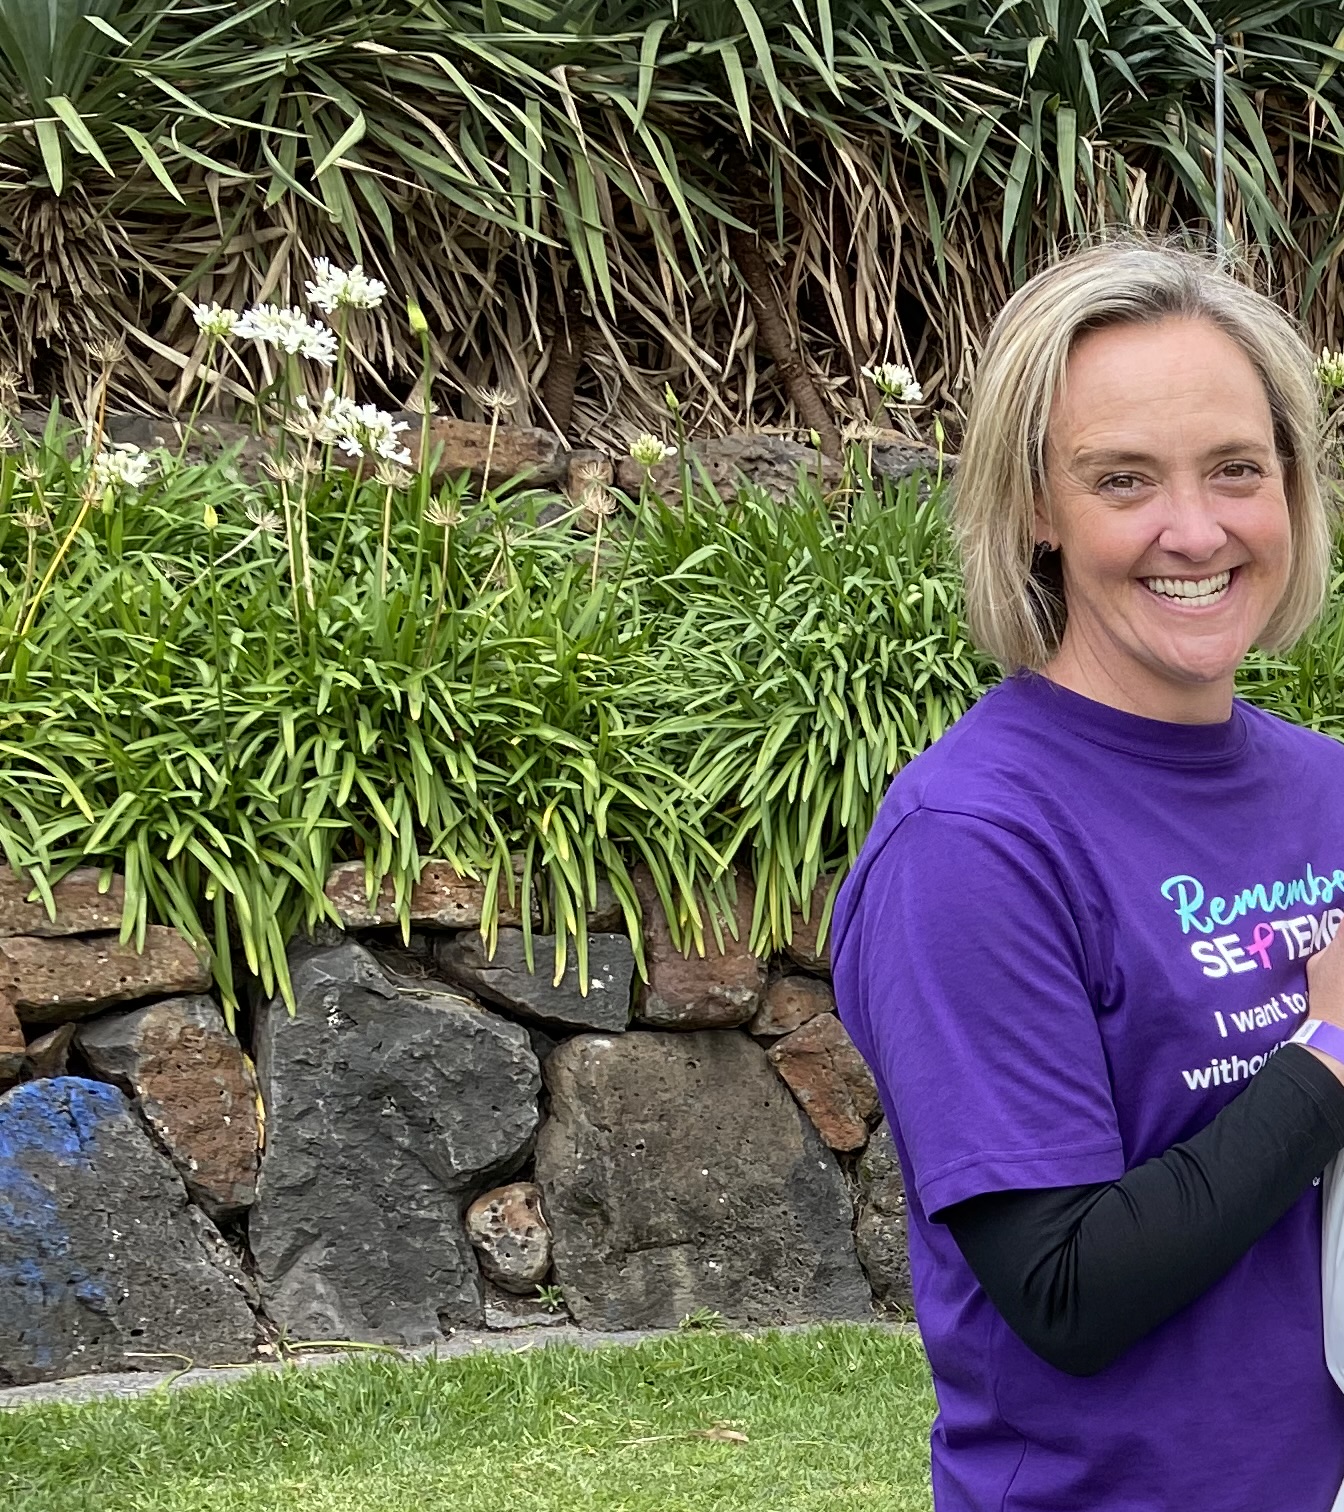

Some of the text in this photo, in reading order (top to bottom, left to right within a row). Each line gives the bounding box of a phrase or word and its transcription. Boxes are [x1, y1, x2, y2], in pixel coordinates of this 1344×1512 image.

[1214, 1011, 1228, 1038] I
[1229, 996, 1288, 1033] want
[1280, 992, 1307, 1015] to
